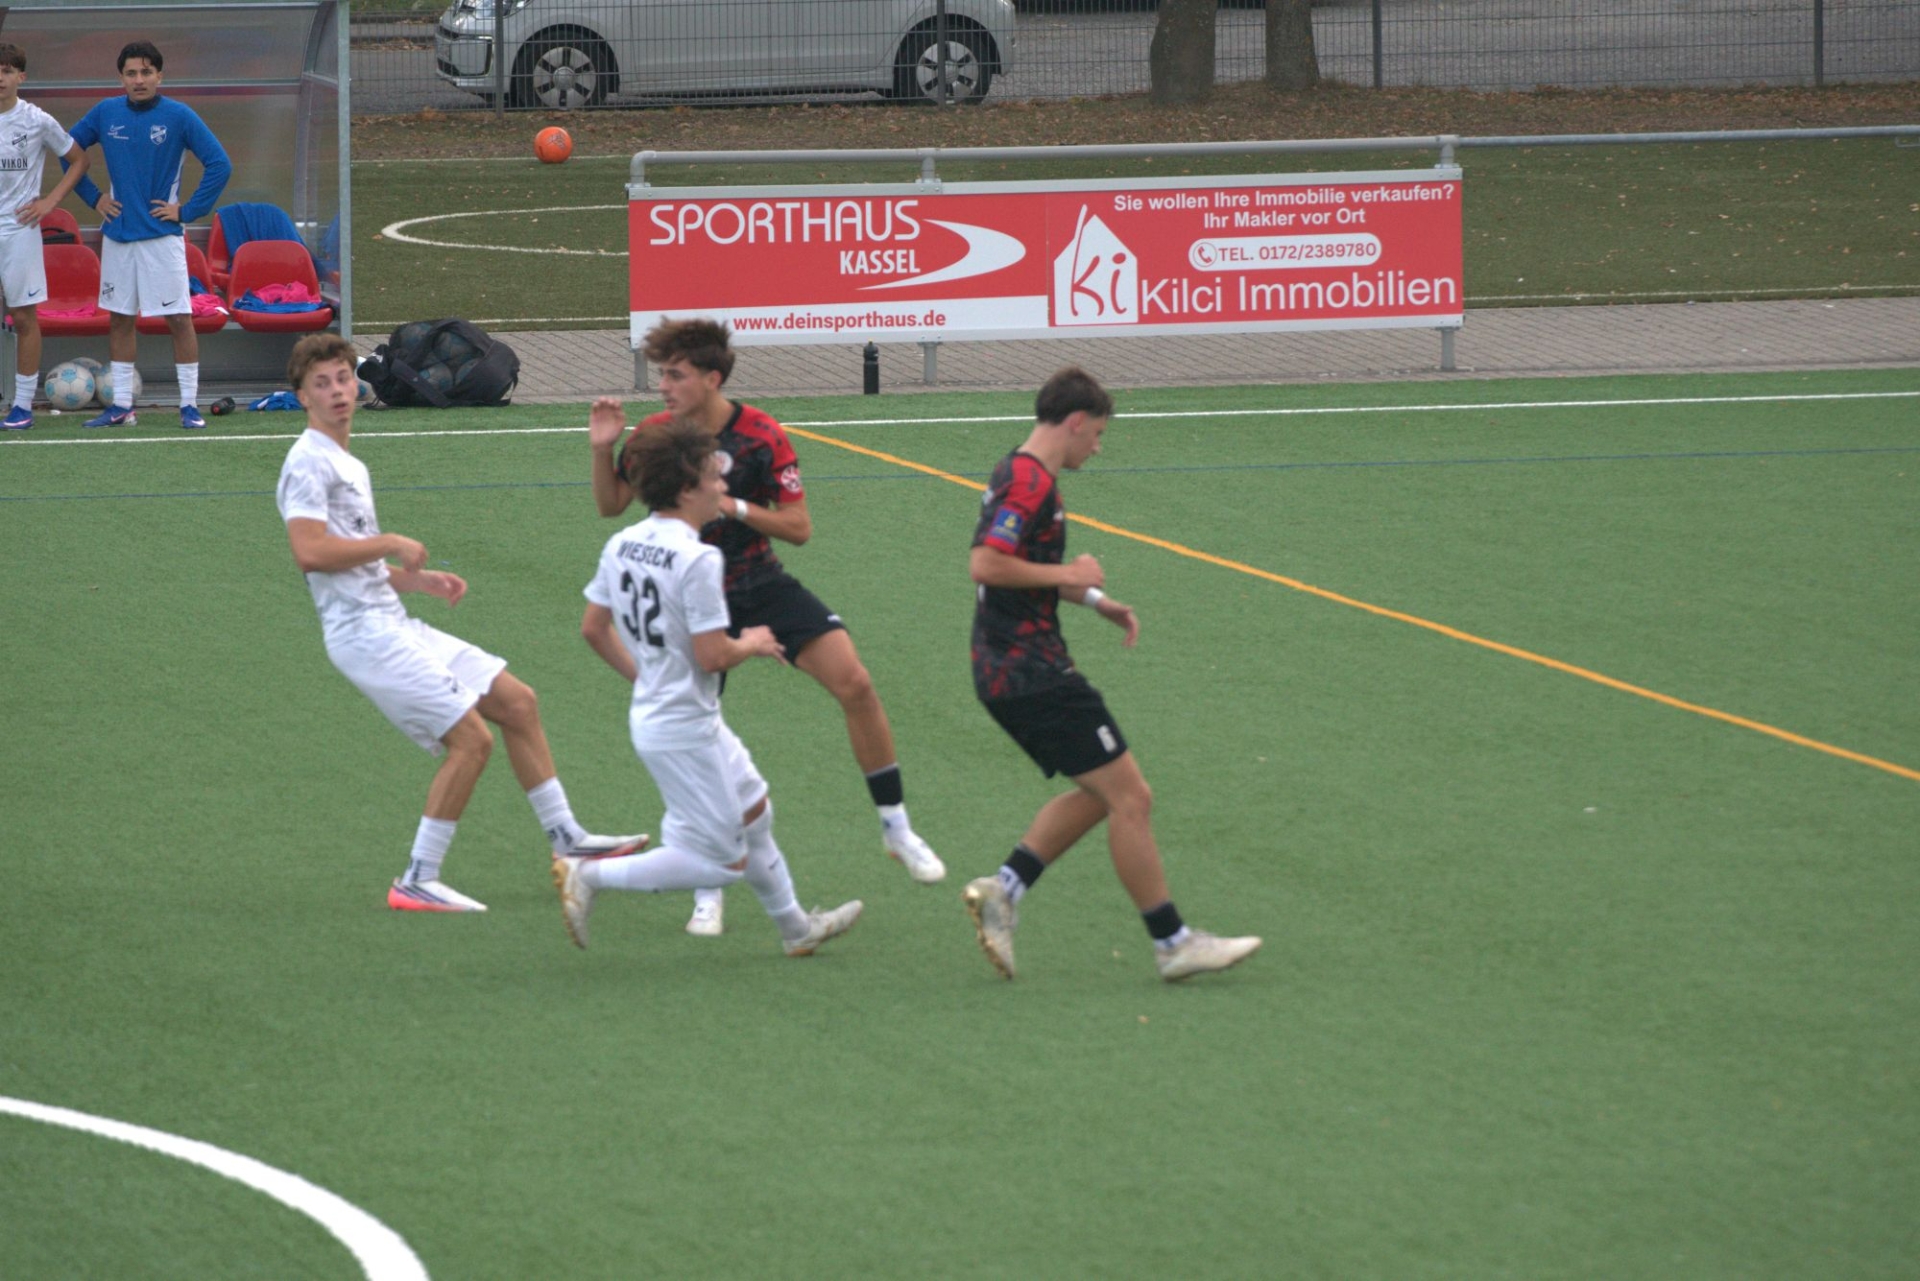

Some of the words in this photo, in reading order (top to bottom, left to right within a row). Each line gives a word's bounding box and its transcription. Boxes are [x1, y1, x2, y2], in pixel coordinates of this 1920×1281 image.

[1114, 195, 1143, 211] Sie
[1148, 193, 1208, 210] wollen
[1214, 191, 1249, 207] Ihre
[1255, 188, 1345, 206] Immobilie
[1351, 184, 1455, 203] verkaufen?
[650, 200, 920, 245] SPORTHAUS
[1204, 213, 1228, 228] Ihr
[1234, 211, 1296, 227] Makler
[1301, 211, 1331, 225] vor
[1336, 208, 1366, 223] Ort
[840, 249, 921, 275] KASSEL
[1218, 247, 1254, 261] TEL.
[1259, 242, 1377, 261] 0172/2389780
[1142, 277, 1222, 314] Kilci
[1240, 271, 1455, 311] Immobilien
[733, 310, 946, 332] www.deinsporthaus.de
[617, 540, 676, 570] WIESECK
[621, 569, 665, 647] 32
